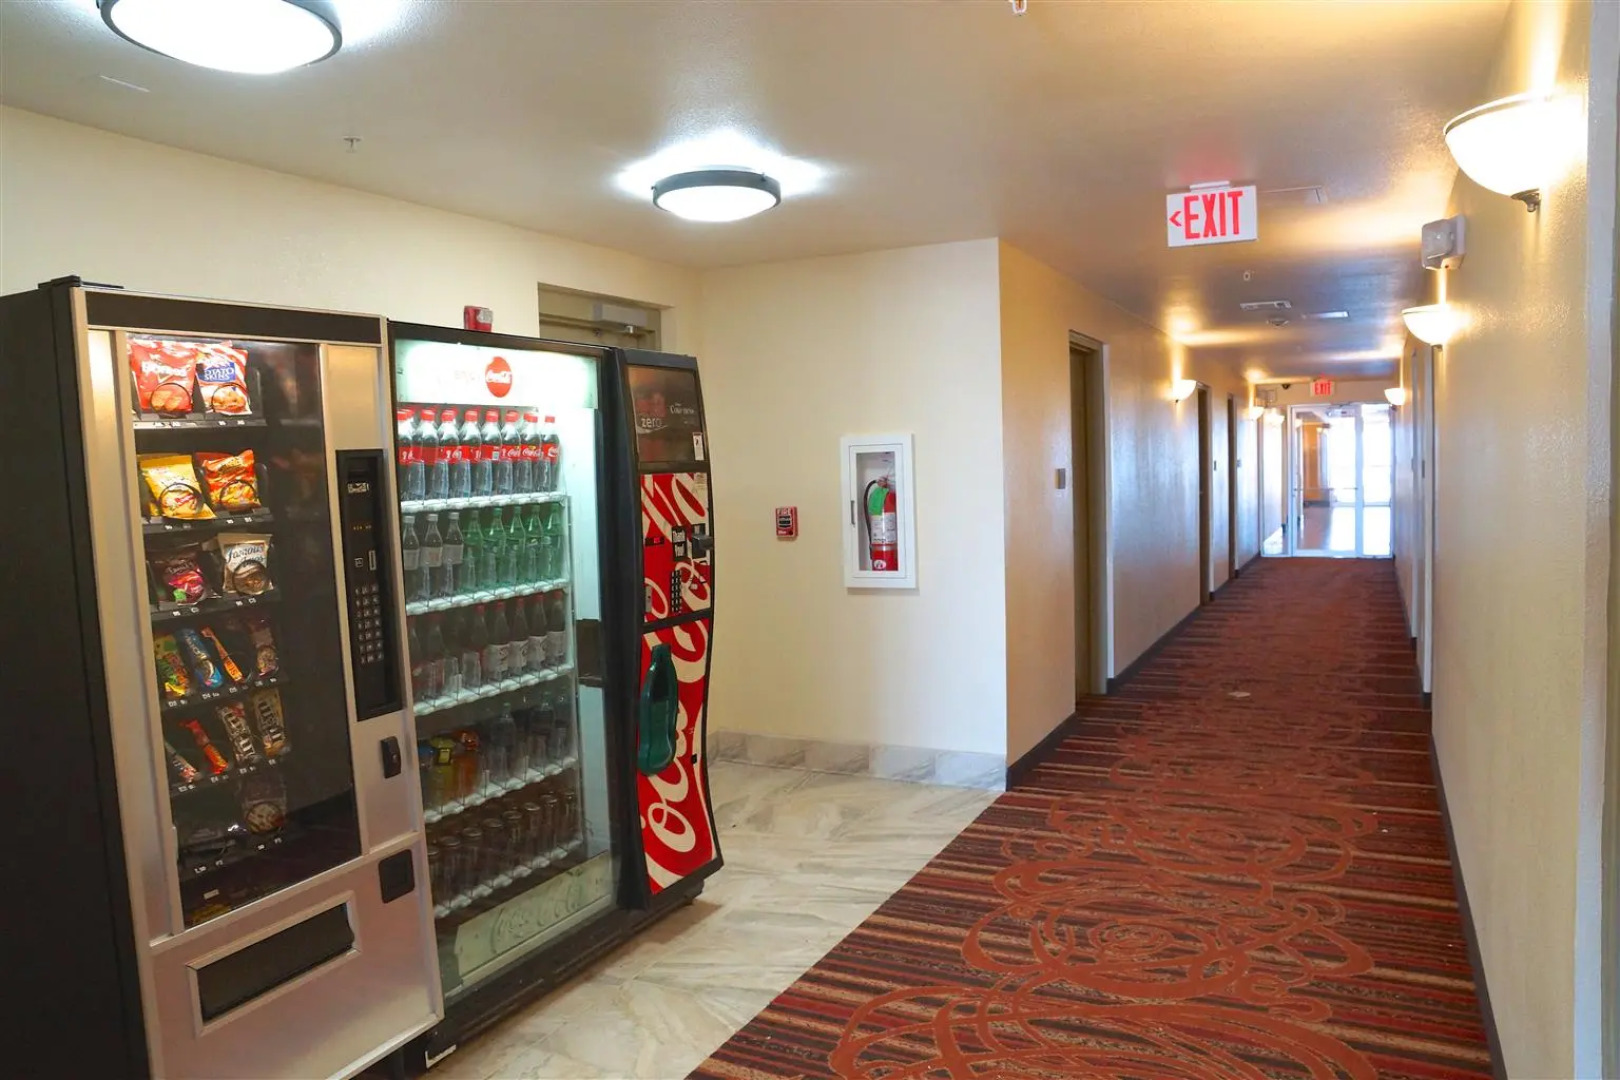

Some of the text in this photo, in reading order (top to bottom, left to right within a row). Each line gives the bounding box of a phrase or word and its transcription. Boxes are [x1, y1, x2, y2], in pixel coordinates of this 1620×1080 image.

[1184, 190, 1243, 240] EXIT
[203, 366, 235, 375] OTATO
[1313, 380, 1333, 396] EXIT
[640, 417, 662, 428] zero
[226, 544, 265, 563] Famous
